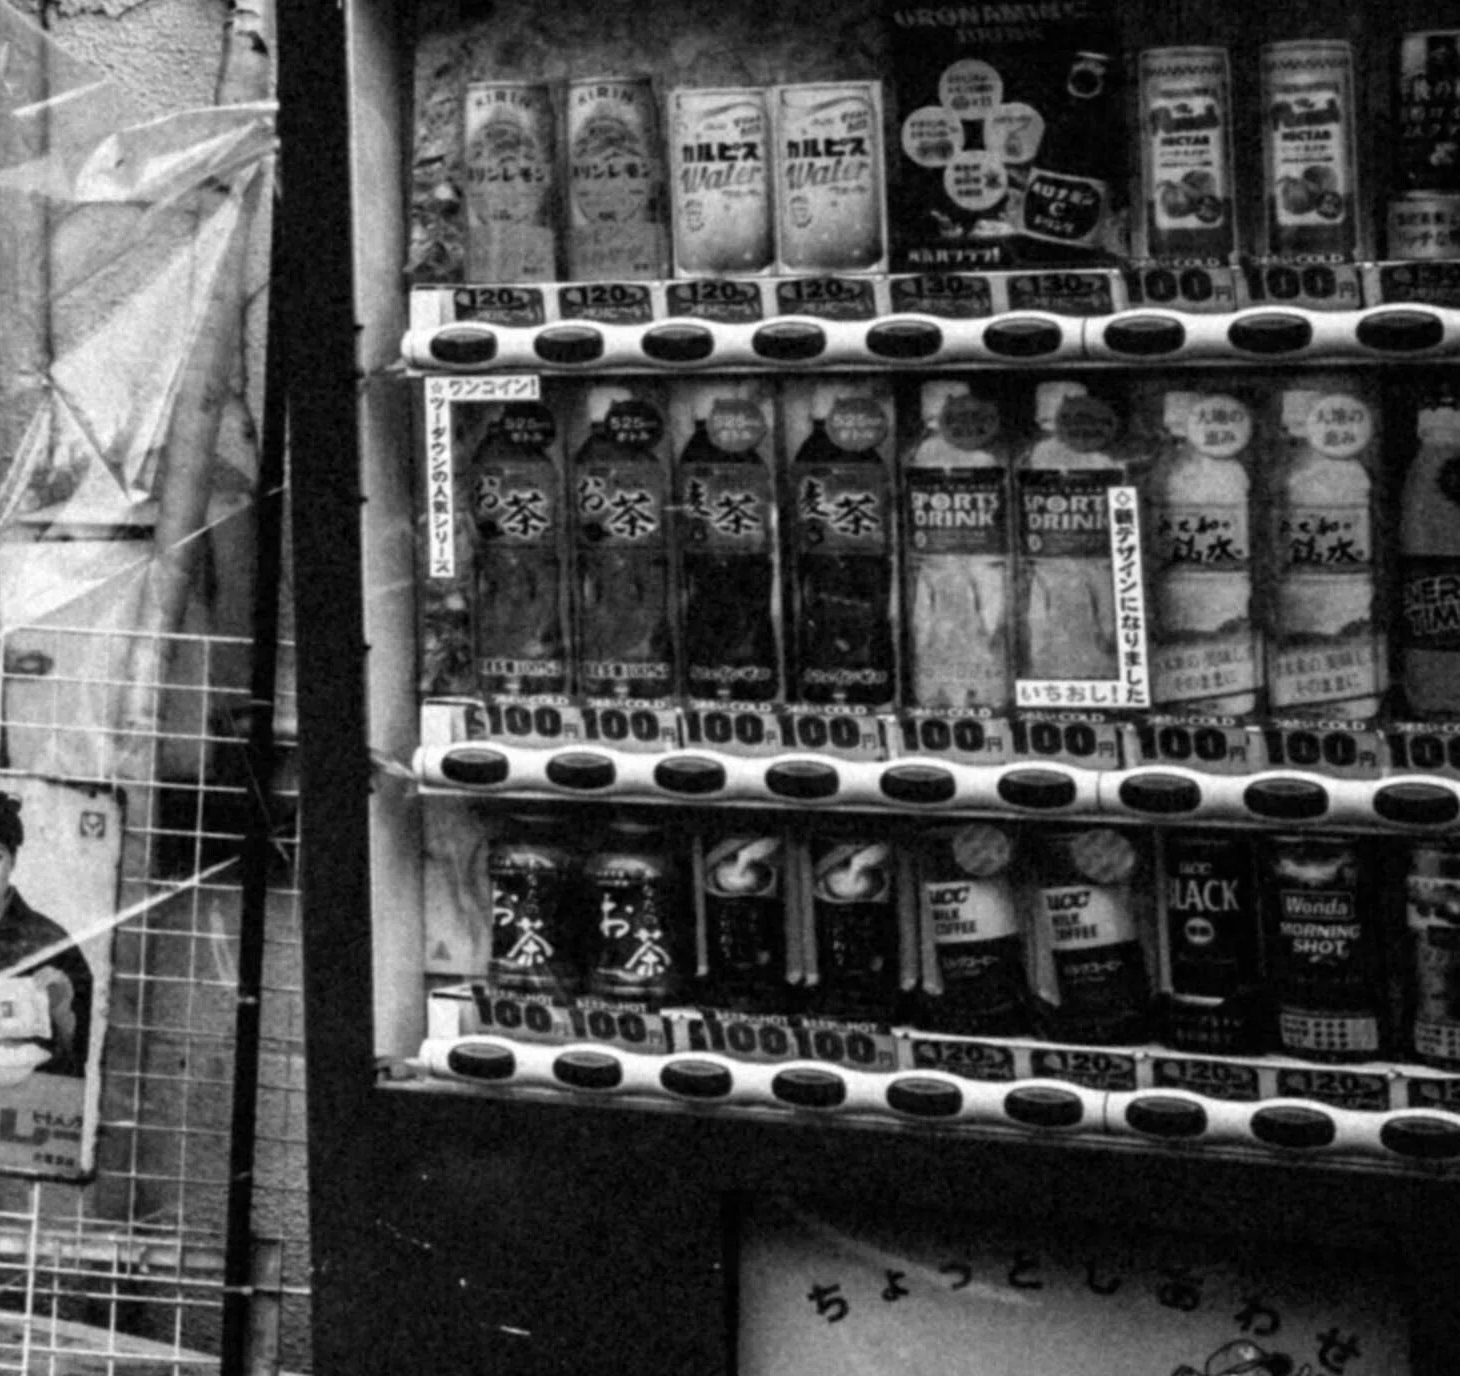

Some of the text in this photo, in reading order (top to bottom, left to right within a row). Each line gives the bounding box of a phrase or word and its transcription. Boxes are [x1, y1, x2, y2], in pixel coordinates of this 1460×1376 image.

[474, 89, 533, 110] KIRIN
[577, 85, 635, 105] KIRIN
[682, 142, 760, 162] カルピス
[787, 137, 868, 158] カルピス
[572, 161, 650, 181] キリンレモン
[680, 162, 762, 190] Water
[784, 159, 869, 188] Water
[474, 476, 547, 536] お茶
[577, 476, 658, 537] お茶
[687, 480, 759, 535] 麦茶
[800, 479, 879, 535] 麦茶
[911, 492, 999, 512] SPORTS
[1024, 493, 1109, 513] SPORT
[914, 510, 995, 528] DRINK
[1029, 512, 1109, 531] DRIN
[1021, 683, 1120, 705] いちおし!
[929, 887, 970, 906] UCC
[1046, 891, 1091, 911] UCC
[1285, 894, 1350, 915] Wonda
[598, 890, 672, 975] お茶
[1280, 922, 1362, 940] MORNING
[1291, 939, 1351, 960] SHOT
[807, 1260, 1361, 1374] ちょっとしあわせ
